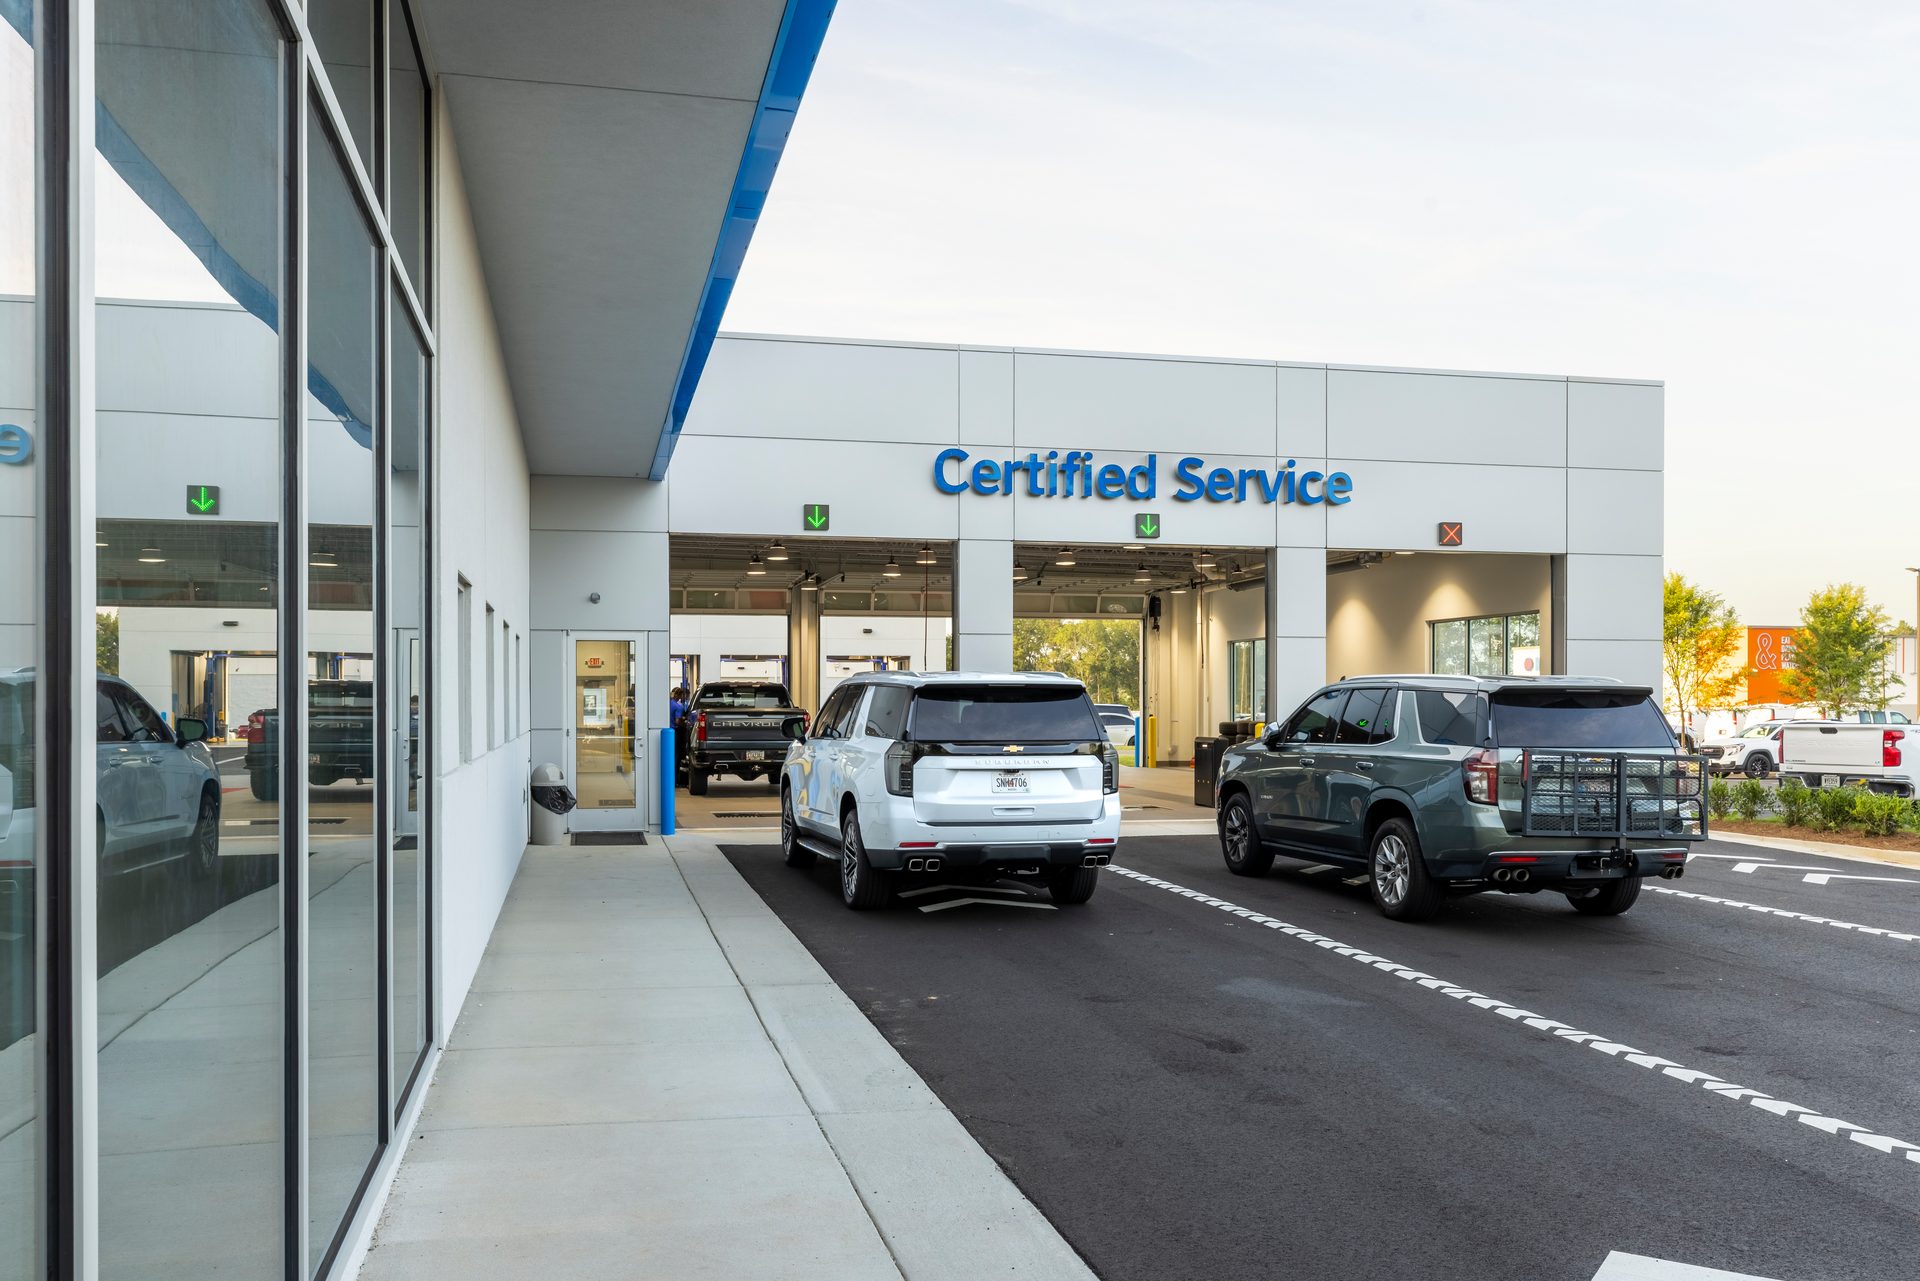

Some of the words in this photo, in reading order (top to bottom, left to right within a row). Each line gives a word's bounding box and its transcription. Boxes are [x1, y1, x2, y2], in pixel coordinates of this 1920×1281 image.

[934, 448, 1156, 499] Certified
[1171, 457, 1353, 505] Service
[589, 658, 600, 666] EXIT
